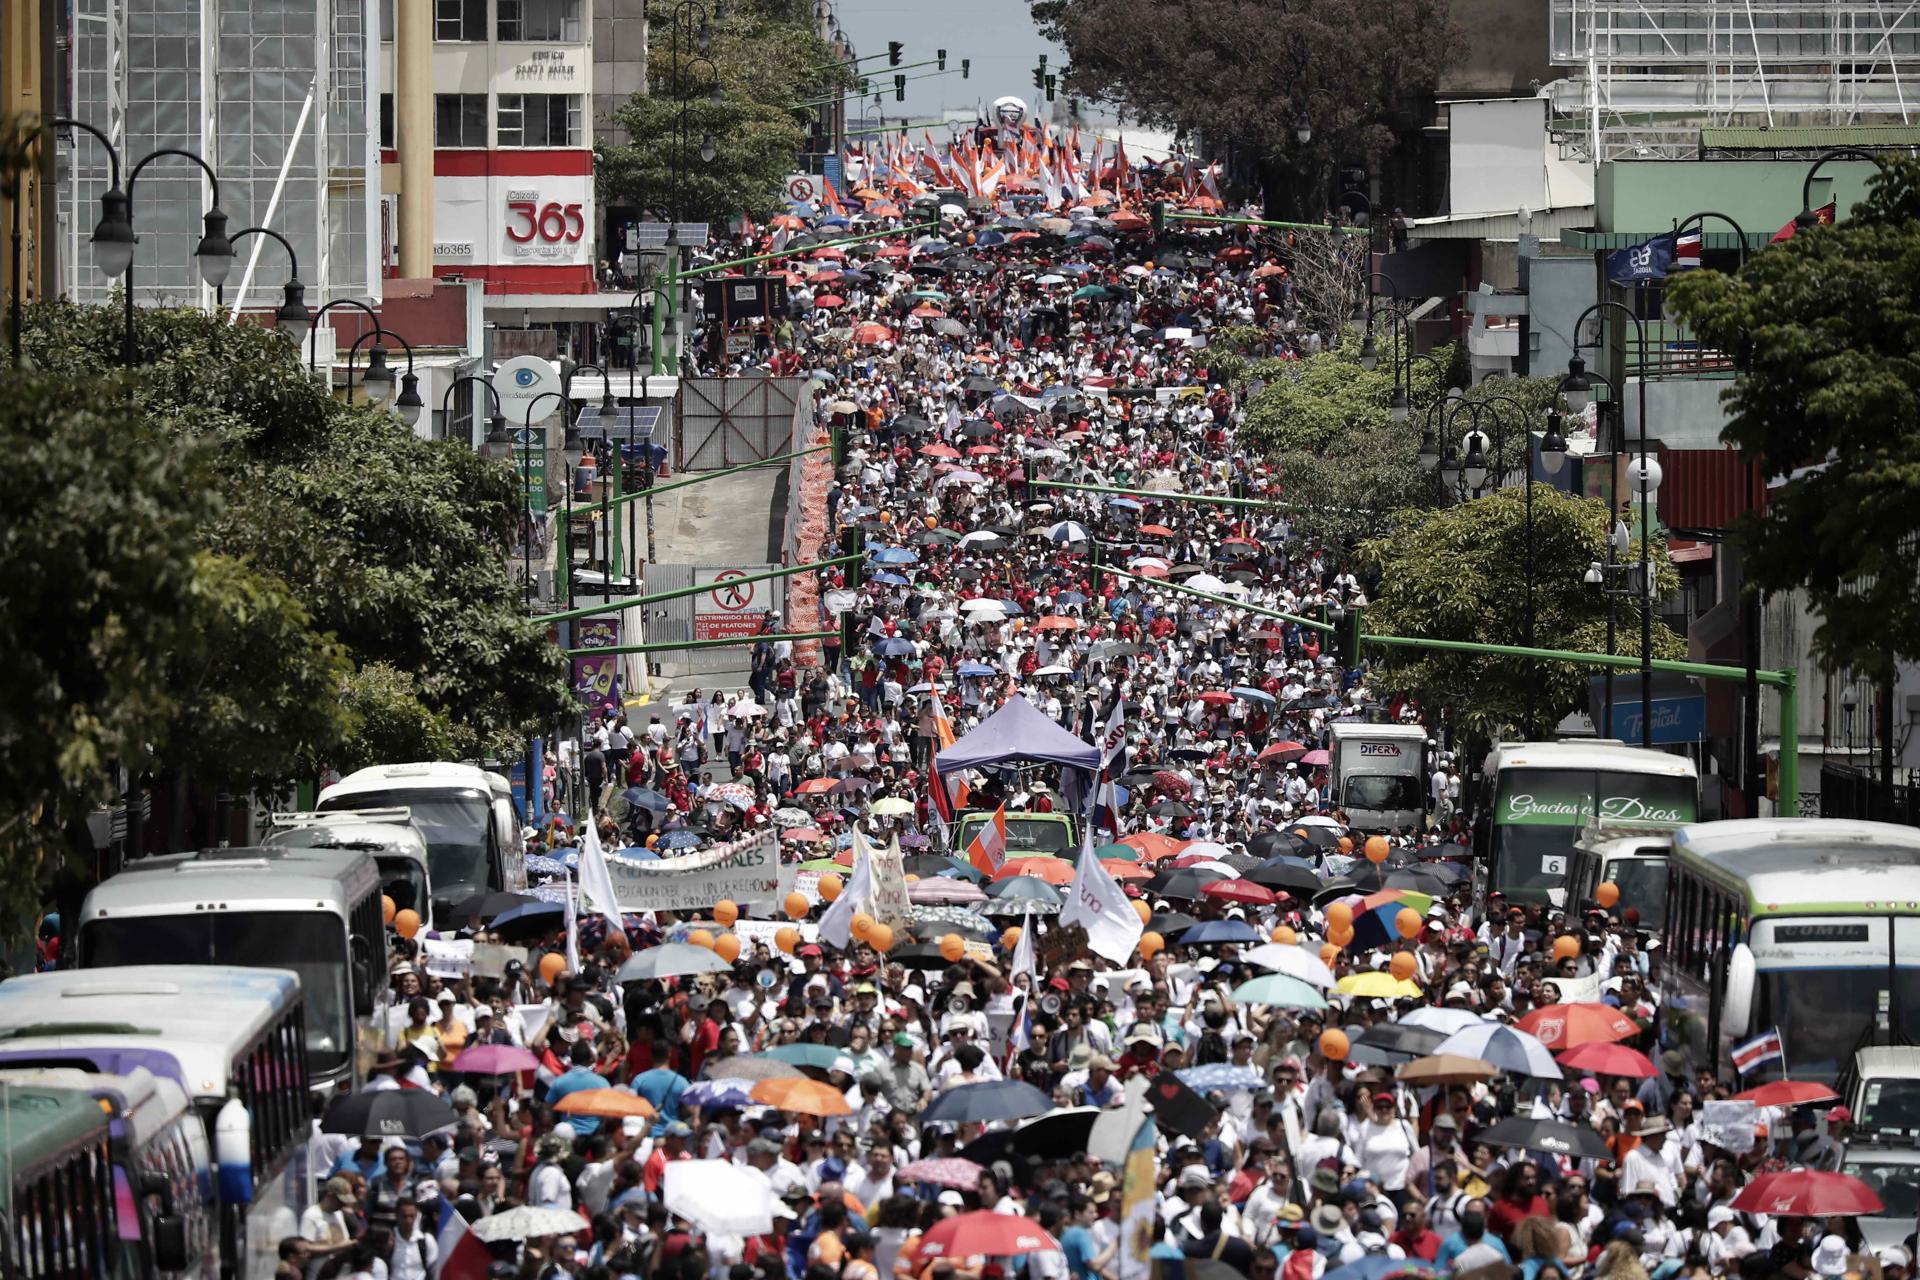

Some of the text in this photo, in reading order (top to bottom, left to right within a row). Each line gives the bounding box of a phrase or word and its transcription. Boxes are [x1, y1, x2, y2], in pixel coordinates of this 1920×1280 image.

[532, 51, 565, 60] EDIFICIO
[509, 191, 539, 200] Calzado
[506, 202, 584, 242] 365
[1507, 794, 1577, 821] Gracias
[1600, 797, 1681, 821] Dios
[1548, 860, 1559, 873] 6
